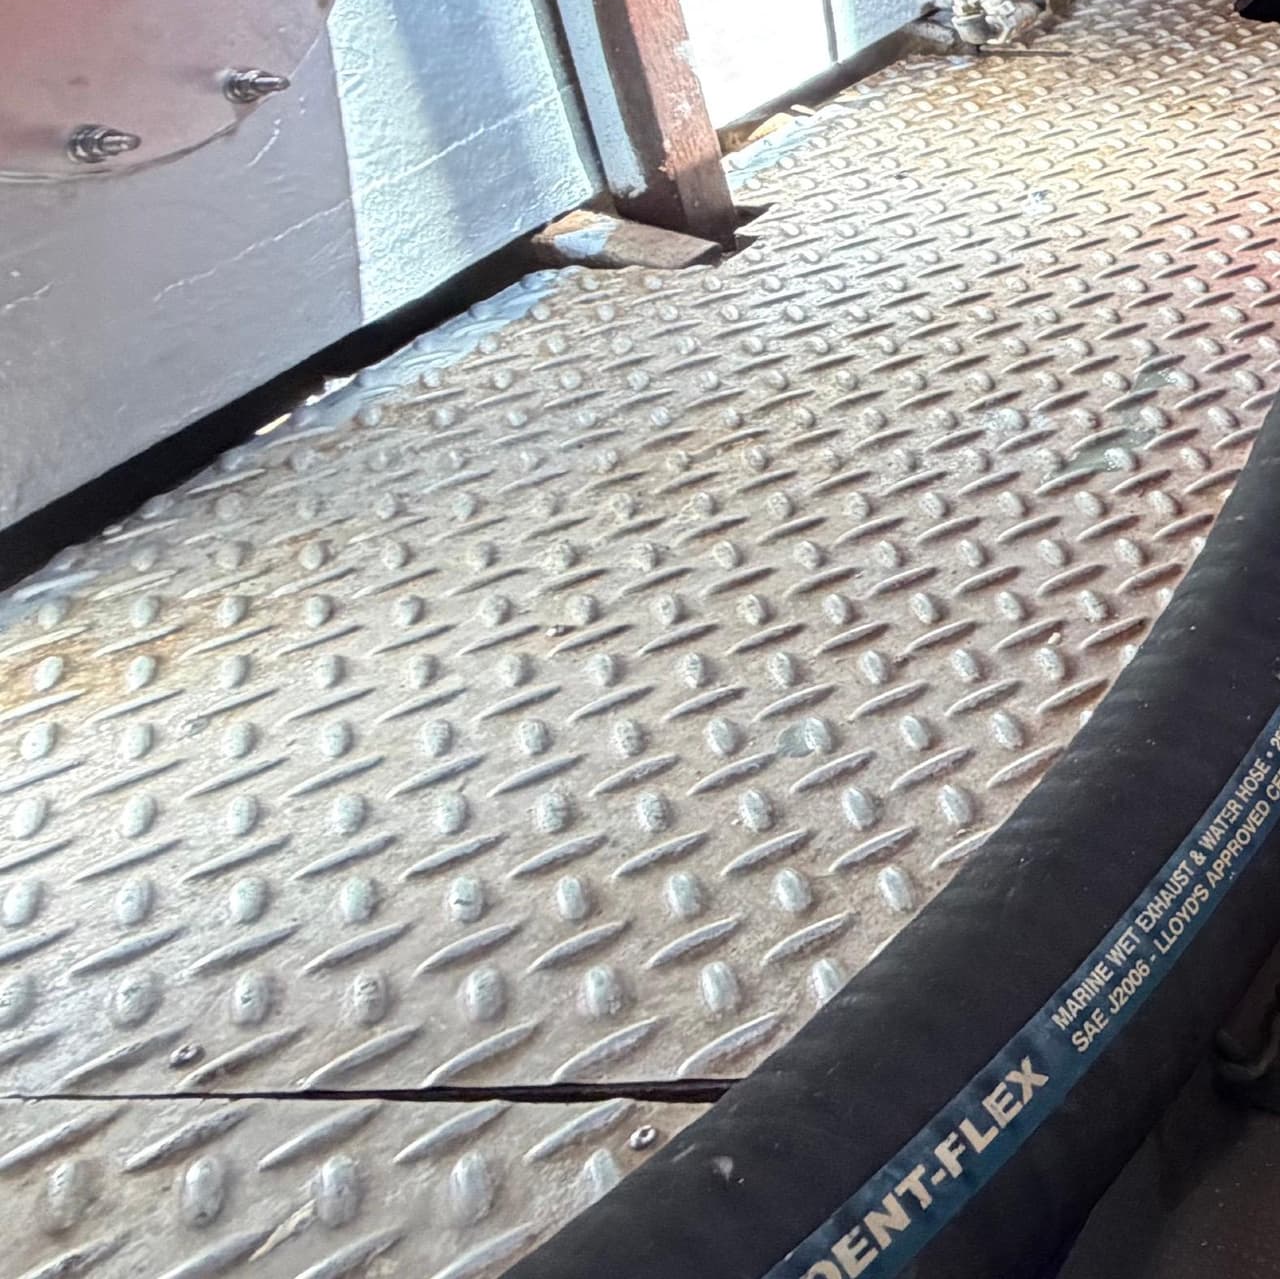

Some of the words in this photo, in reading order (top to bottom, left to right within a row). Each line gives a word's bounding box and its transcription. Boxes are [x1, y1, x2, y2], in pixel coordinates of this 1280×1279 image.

[1051, 961, 1114, 1031] MARINE
[1105, 926, 1141, 966] WET
[1135, 860, 1195, 933] EXHAUST
[1189, 849, 1206, 866] &
[1198, 799, 1244, 851] WATER
[1235, 758, 1271, 803] HOSE
[1071, 1008, 1109, 1053] SAE
[1109, 959, 1150, 1014] J2006
[1153, 884, 1209, 954] LLOYD'S
[1206, 799, 1271, 888] APPROVED
